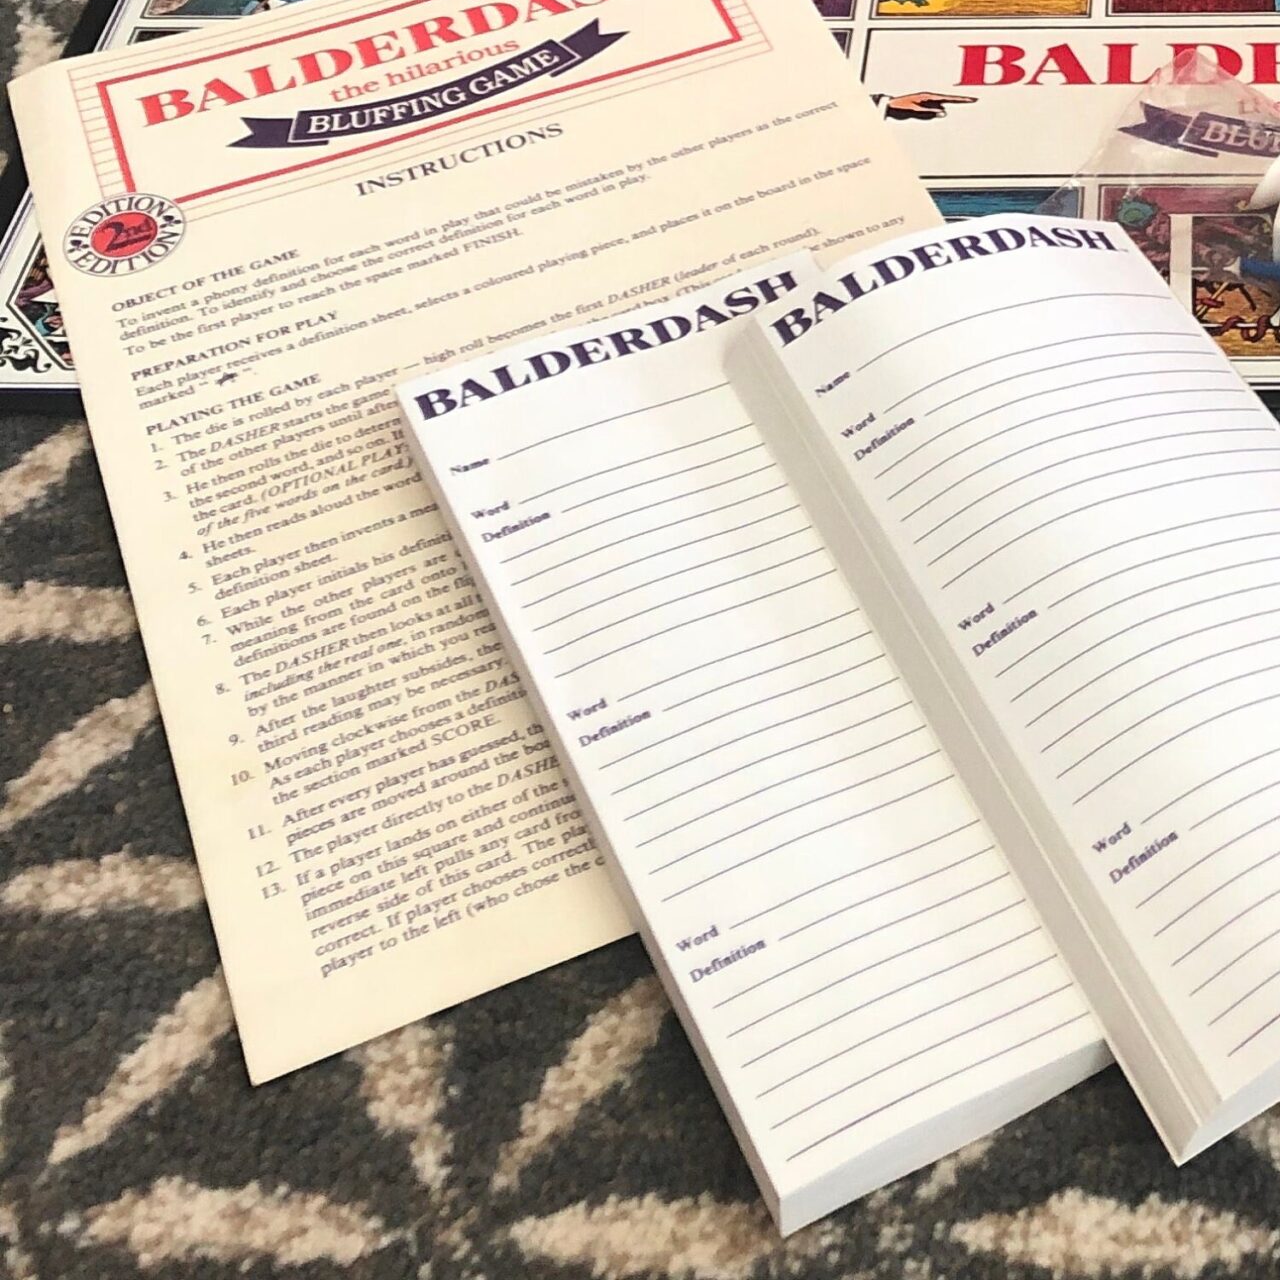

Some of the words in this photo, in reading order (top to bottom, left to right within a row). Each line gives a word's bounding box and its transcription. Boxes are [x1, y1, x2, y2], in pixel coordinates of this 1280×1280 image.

[307, 85, 466, 135] BLUFFING
[468, 49, 560, 96] GAME
[330, 79, 379, 103] the
[384, 39, 521, 88] hilarious
[355, 123, 564, 198] INSTRUCTIONS
[71, 196, 176, 239] EDITION
[141, 300, 186, 321] invent
[202, 281, 248, 304] phony
[251, 259, 320, 287] definition
[322, 251, 344, 265] for
[346, 240, 380, 257] each
[383, 228, 420, 246] word
[439, 213, 470, 231] play
[472, 203, 501, 219] that
[502, 191, 542, 209] could
[563, 166, 624, 190] mistaken
[645, 152, 667, 165] the
[668, 141, 704, 158] other
[706, 126, 754, 148] players
[770, 114, 793, 126] the
[792, 100, 838, 119] correct
[73, 229, 181, 275] EDITION
[110, 284, 177, 312] OBJECT
[180, 276, 205, 292] OF
[210, 264, 244, 282] THE
[248, 248, 298, 271] GAME
[170, 328, 193, 342] the
[196, 318, 226, 334] first
[229, 303, 274, 326] player
[296, 284, 335, 303] reach
[338, 276, 362, 290] the
[364, 265, 404, 284] space
[405, 246, 459, 270] marked
[462, 227, 523, 252] FINISH.
[769, 225, 1117, 347] BALDERDASH
[130, 336, 251, 382] PREPARATION
[254, 324, 291, 344] FOR
[294, 310, 338, 332] PLAY
[414, 271, 799, 420] BALDERDASH
[145, 402, 223, 436] PLAYING
[228, 390, 264, 410] THE
[267, 372, 320, 398] GAME
[815, 370, 852, 397] Name
[179, 445, 206, 462] The
[208, 422, 280, 453] DASHER
[282, 408, 324, 429] starts
[324, 400, 349, 416] the
[351, 389, 392, 410] game
[840, 413, 877, 440] Word
[853, 415, 916, 462] Definition
[450, 455, 490, 476] Name
[227, 524, 264, 545] then
[264, 509, 307, 532] reads
[308, 494, 354, 518] aloud
[354, 485, 380, 502] the
[381, 470, 423, 493] word
[470, 500, 510, 520] Word
[481, 512, 552, 544] Definition
[957, 602, 995, 631] Word
[971, 608, 1039, 658] Definition
[567, 697, 608, 722] Word
[578, 708, 652, 749] Definition
[271, 784, 298, 805] the
[301, 762, 361, 794] section
[364, 737, 428, 771] marked
[430, 711, 501, 747] SCORE.
[291, 840, 323, 863] The
[324, 820, 379, 854] player
[379, 796, 445, 834] directly
[465, 778, 493, 799] the
[1092, 821, 1133, 853] Word
[1108, 830, 1179, 884] Definition
[318, 941, 375, 979] player
[401, 920, 430, 943] the
[432, 907, 462, 931] left
[464, 888, 511, 921] (who
[511, 869, 561, 900] chose
[562, 857, 591, 880] the
[676, 924, 720, 953] Word
[689, 937, 767, 983] Definition
